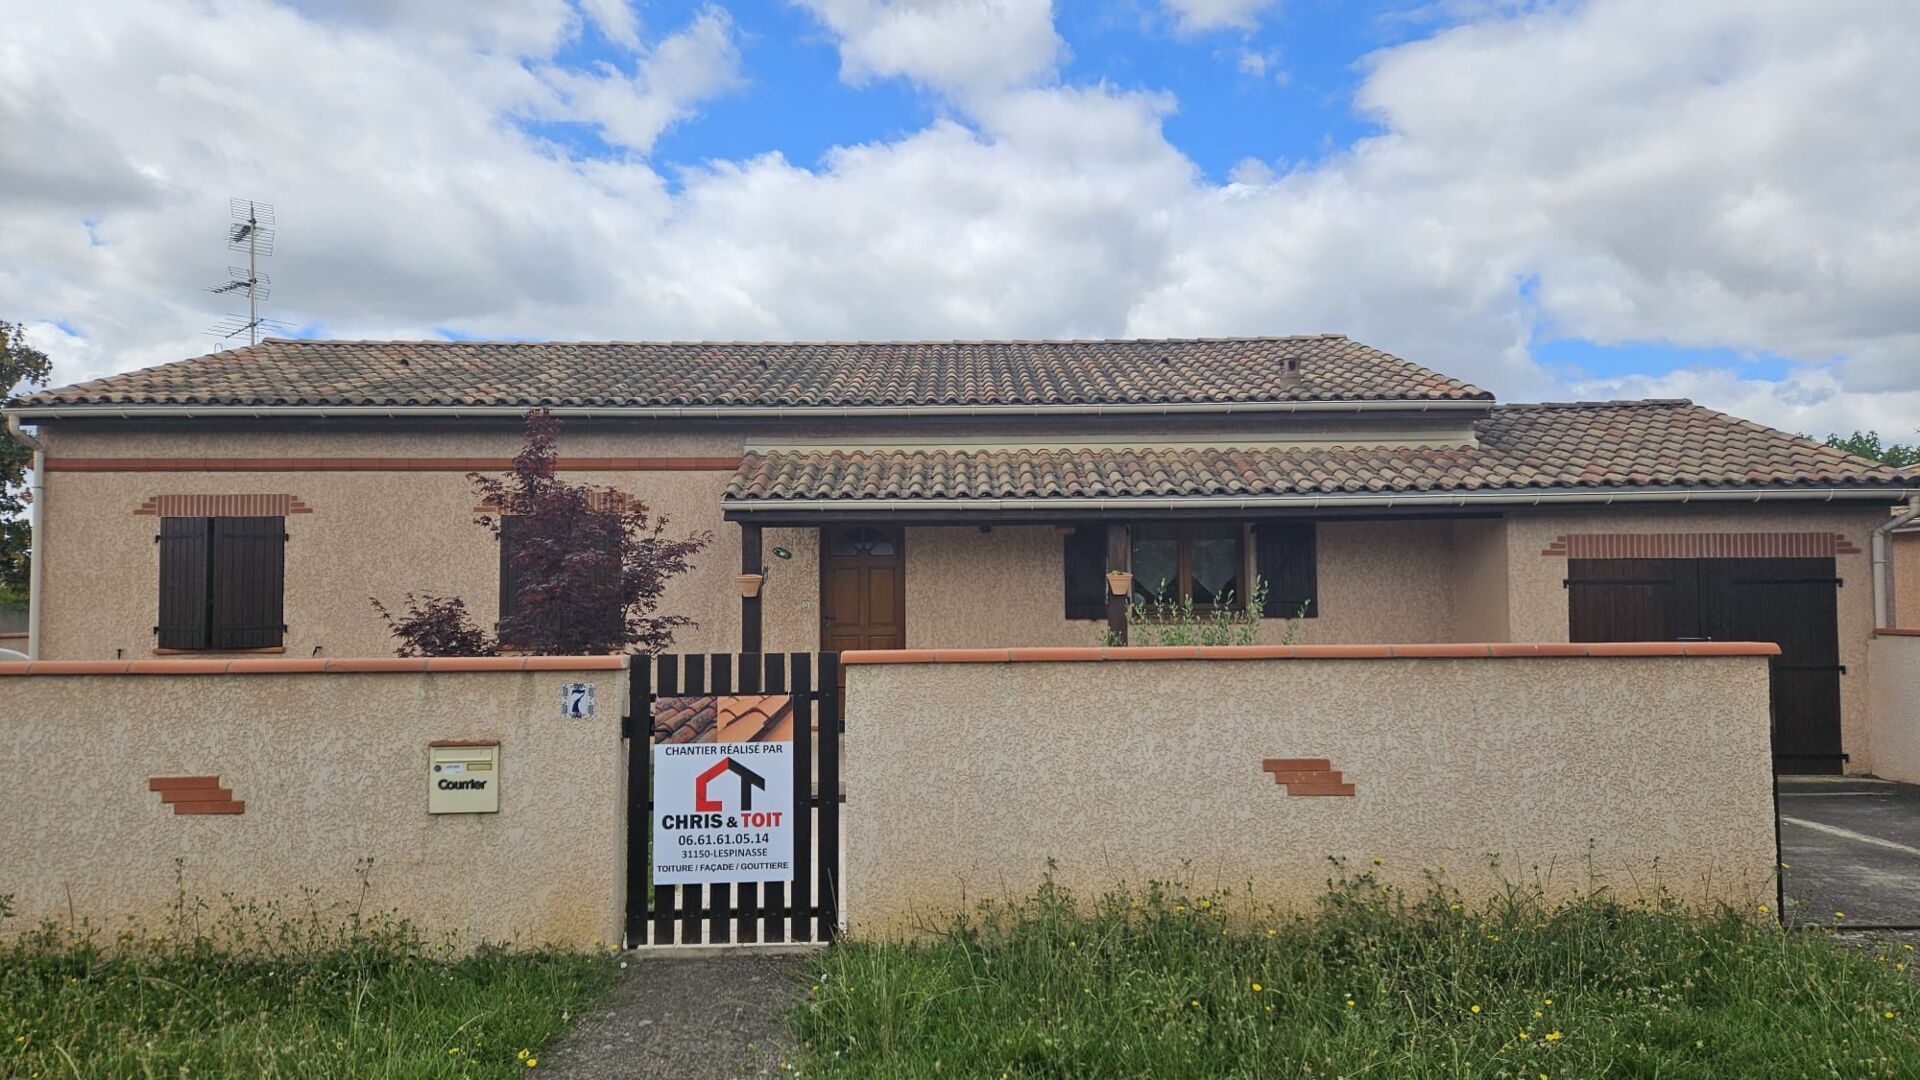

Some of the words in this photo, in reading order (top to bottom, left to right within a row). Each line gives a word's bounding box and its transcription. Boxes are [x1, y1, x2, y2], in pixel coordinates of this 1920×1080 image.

[570, 689, 586, 713] 7
[665, 745, 717, 756] CHANTIER
[720, 743, 760, 755] RÉALISÉ
[763, 744, 783, 754] PAR
[438, 778, 487, 790] Courrier
[662, 813, 723, 830] CHRIS
[726, 816, 738, 828] &
[741, 812, 783, 828] TOIT
[678, 832, 769, 846] 06.61.61.05.14
[681, 848, 768, 859] 31150-LESPINASSE
[657, 864, 694, 873] TOITURE
[699, 863, 734, 873] FAÇADE
[740, 862, 789, 871] GOUTTIERE
